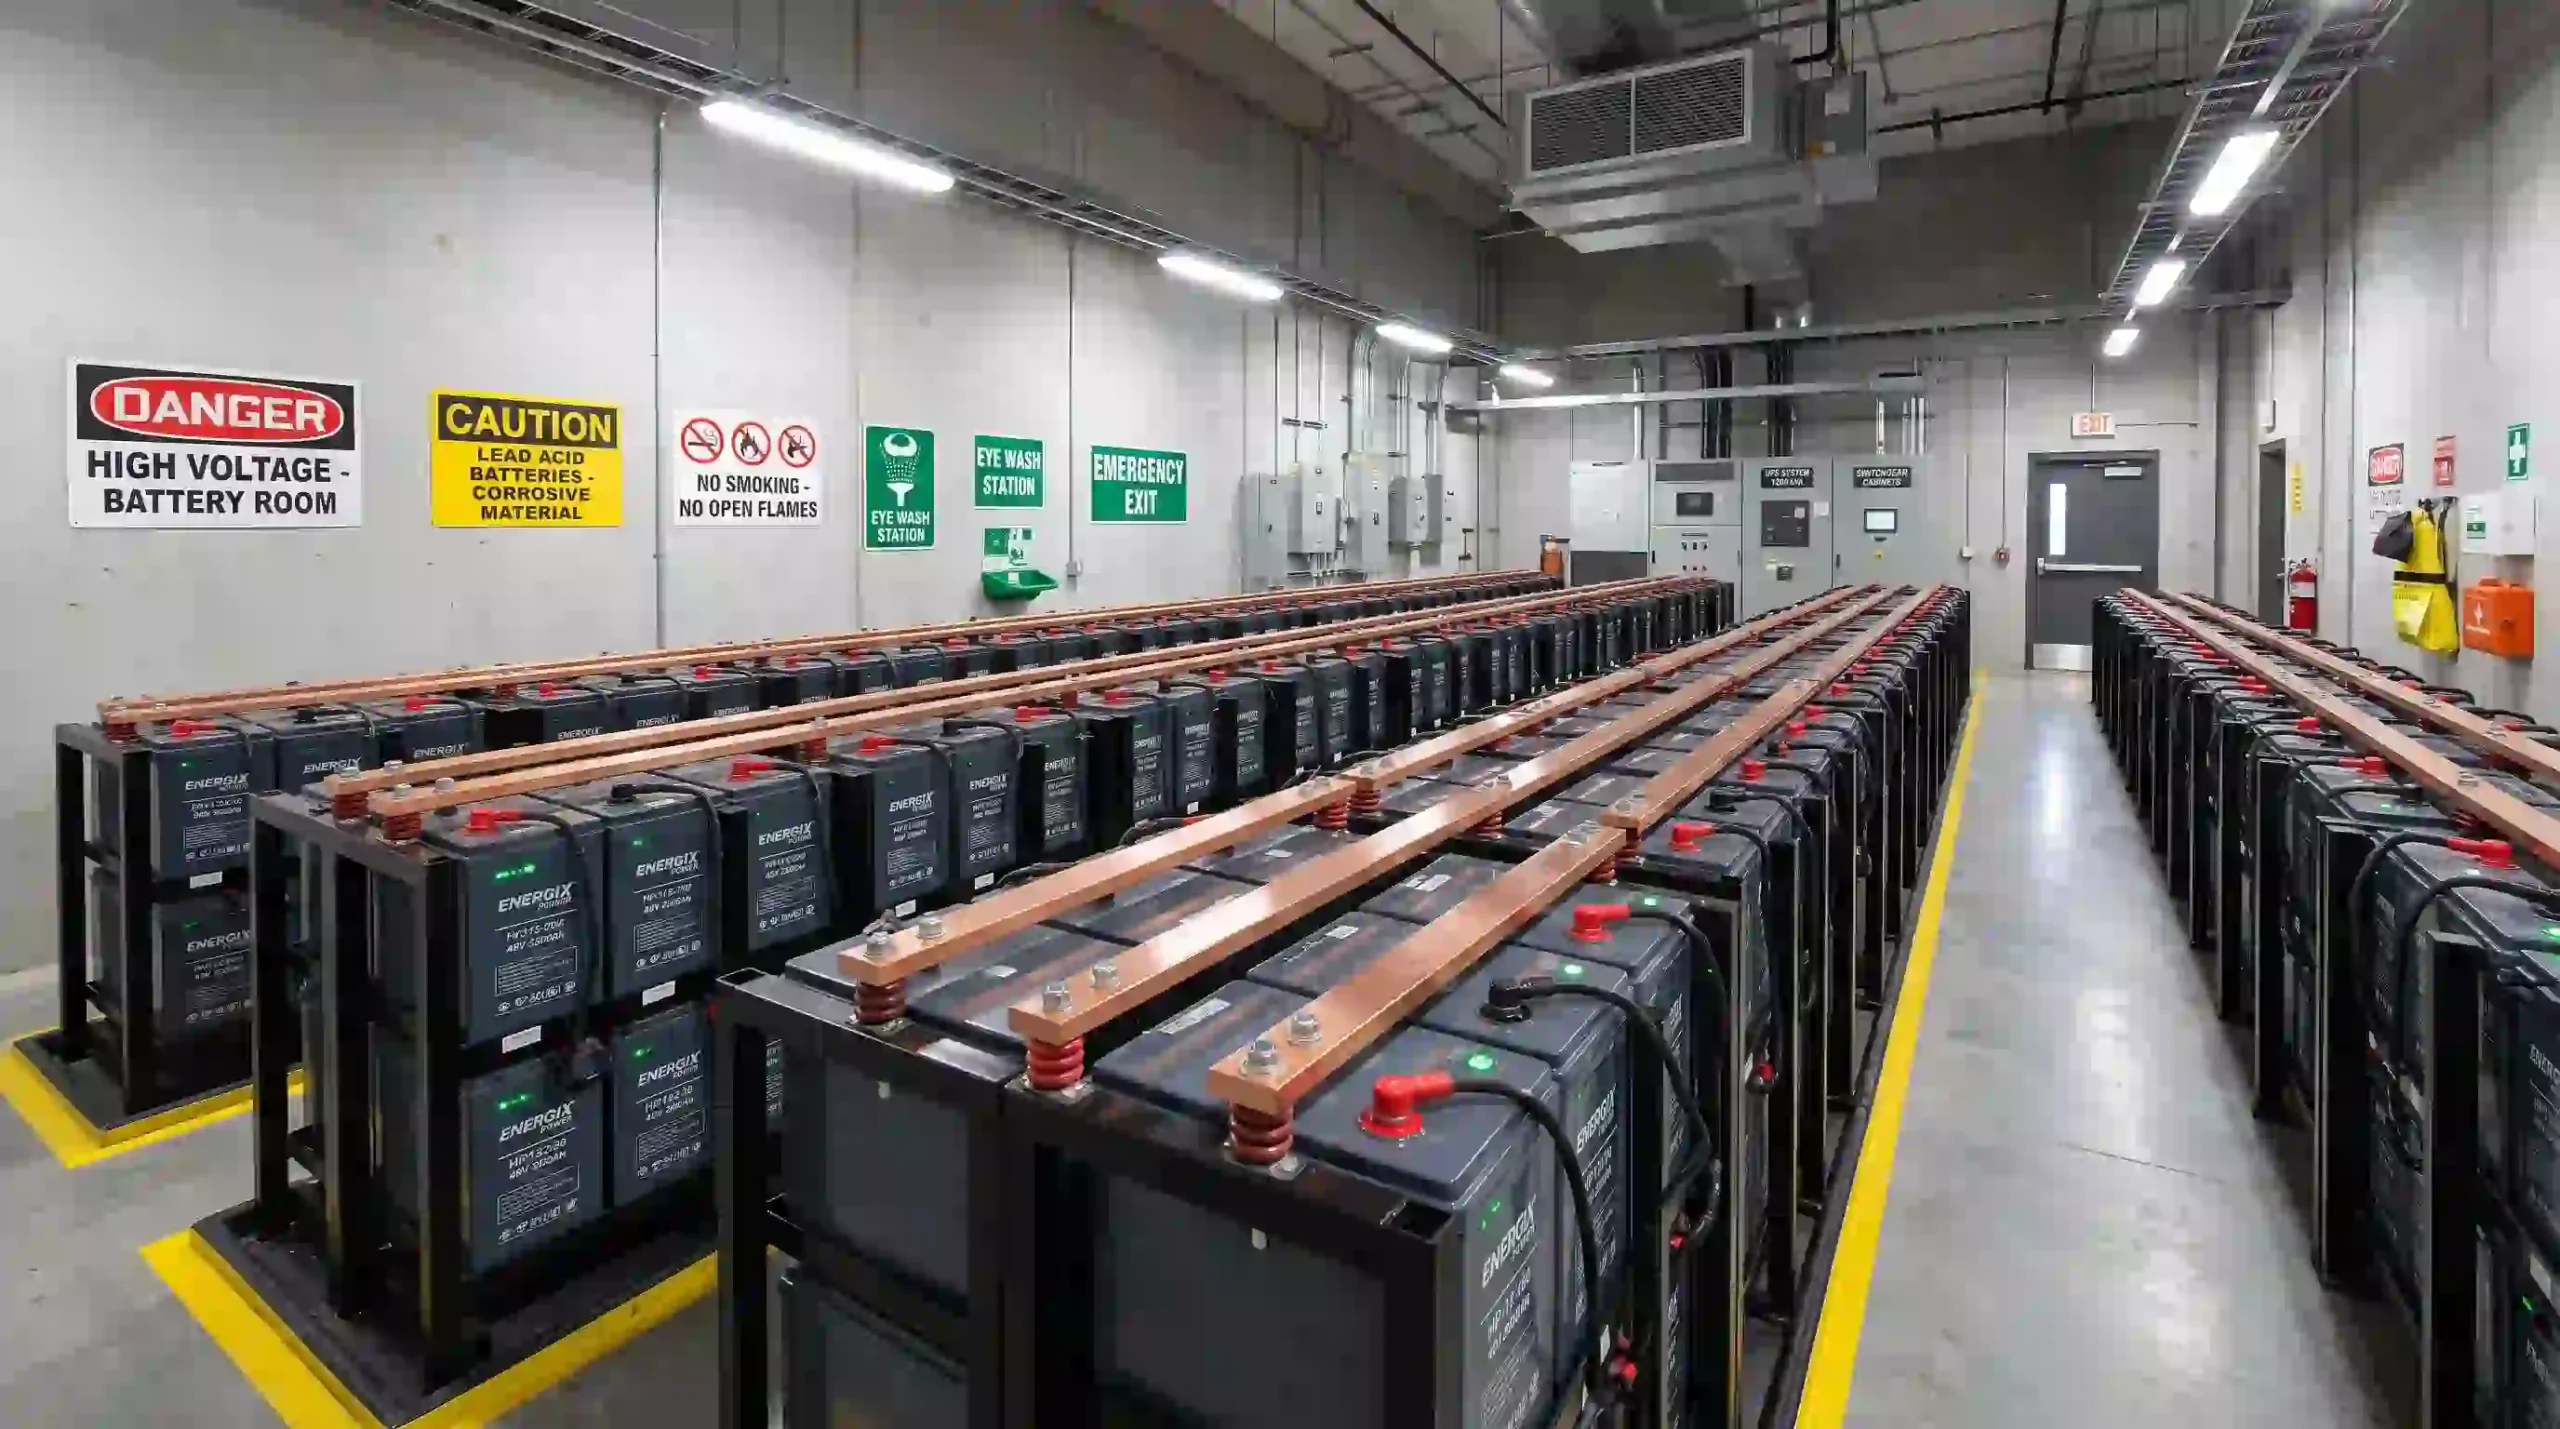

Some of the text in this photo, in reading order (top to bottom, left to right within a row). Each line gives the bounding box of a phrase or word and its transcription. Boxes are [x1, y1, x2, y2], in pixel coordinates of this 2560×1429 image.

[113, 386, 327, 433] DANGER
[445, 402, 612, 443] CAUTION
[87, 449, 176, 479] HIGH
[186, 452, 331, 483] VOLTAGE
[477, 446, 585, 466] LEAD ACID
[976, 446, 1042, 470] EYE WASH
[469, 465, 583, 485] BATTERIES
[1093, 453, 1184, 485] EMERGENCY
[471, 484, 591, 502] CORROSIVE
[696, 473, 721, 493] NO
[725, 474, 800, 495] SMOKING
[982, 474, 1036, 496] STATION
[103, 488, 337, 515] BATTERY ROOM
[480, 504, 583, 521] MATERIAL
[679, 498, 818, 518] NO OPEN FLAMES
[1124, 488, 1158, 515] EXIT
[871, 510, 930, 526] EYE WASH
[877, 527, 926, 543] STATION
[185, 772, 250, 791] ENERGIX
[889, 790, 936, 813] ENERGIX
[758, 821, 815, 846] ENERGIX
[635, 850, 700, 877] ENERGIX
[498, 882, 576, 913] ENERGIX
[187, 929, 252, 953] ENERGIX
[637, 1048, 702, 1088] ENERGIX
[499, 1100, 576, 1143] ENERGIX
[540, 1115, 573, 1134] POWER
[1481, 1195, 1536, 1289] ENERGIX
